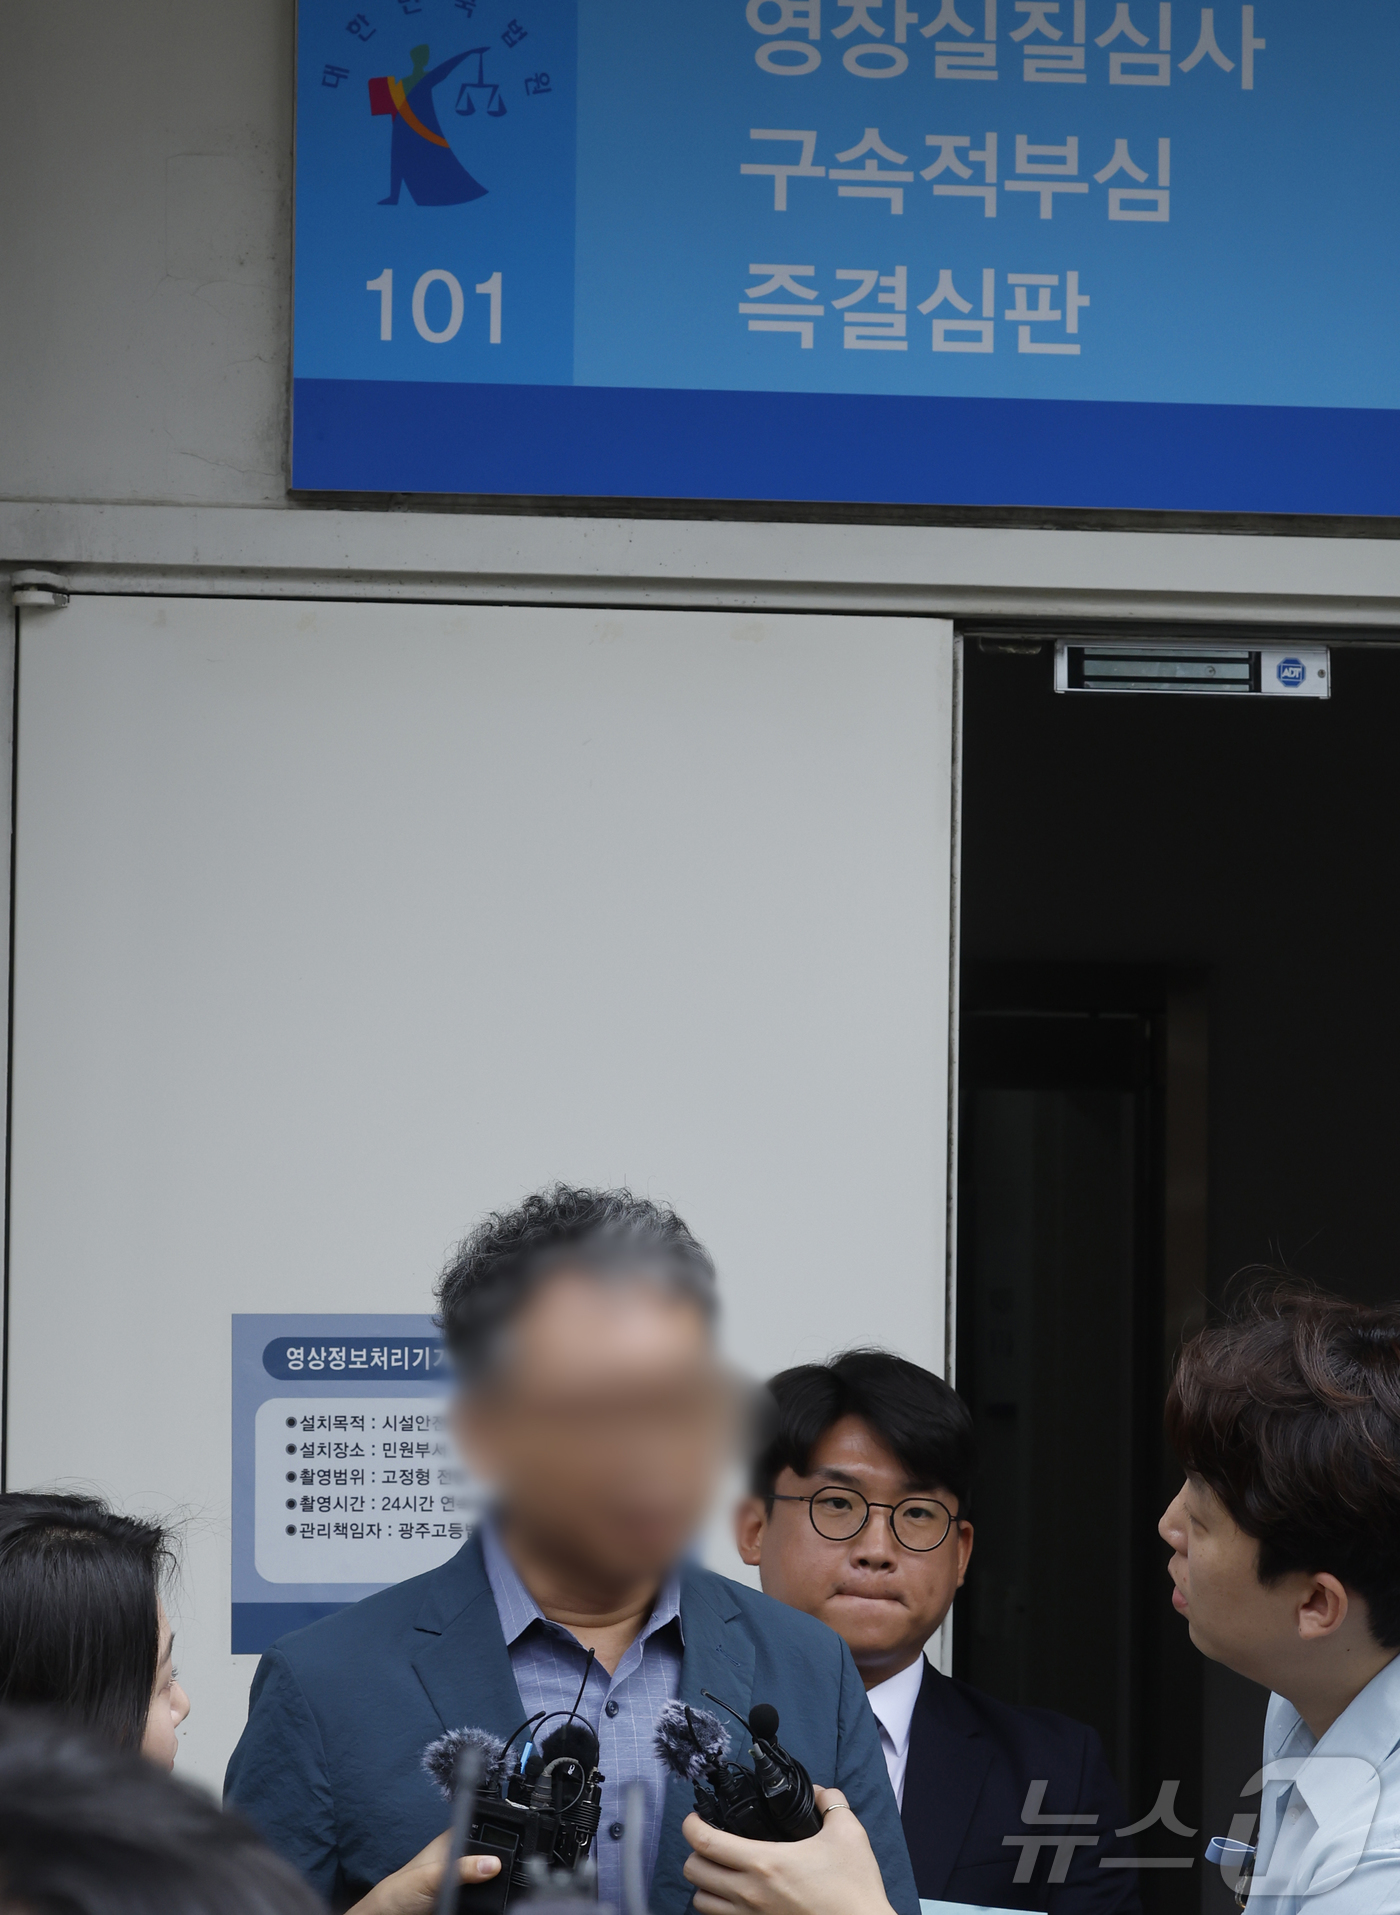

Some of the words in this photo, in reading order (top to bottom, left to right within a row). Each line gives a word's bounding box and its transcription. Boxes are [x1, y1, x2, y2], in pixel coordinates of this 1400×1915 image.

[745, 0, 1266, 90] 영장실질심사
[740, 128, 1171, 222] 구속적부심
[366, 268, 502, 344] 101
[738, 263, 1091, 355] 즉결심판
[1281, 667, 1302, 678] ADT
[300, 1415, 365, 1432] 설치목적
[300, 1441, 366, 1458] 설치장소
[300, 1468, 365, 1485] 촬영범위
[381, 1468, 430, 1485] 고정형
[300, 1495, 366, 1513] 촬영시간
[381, 1495, 434, 1512] 24시간
[300, 1522, 382, 1540] 관리책임자
